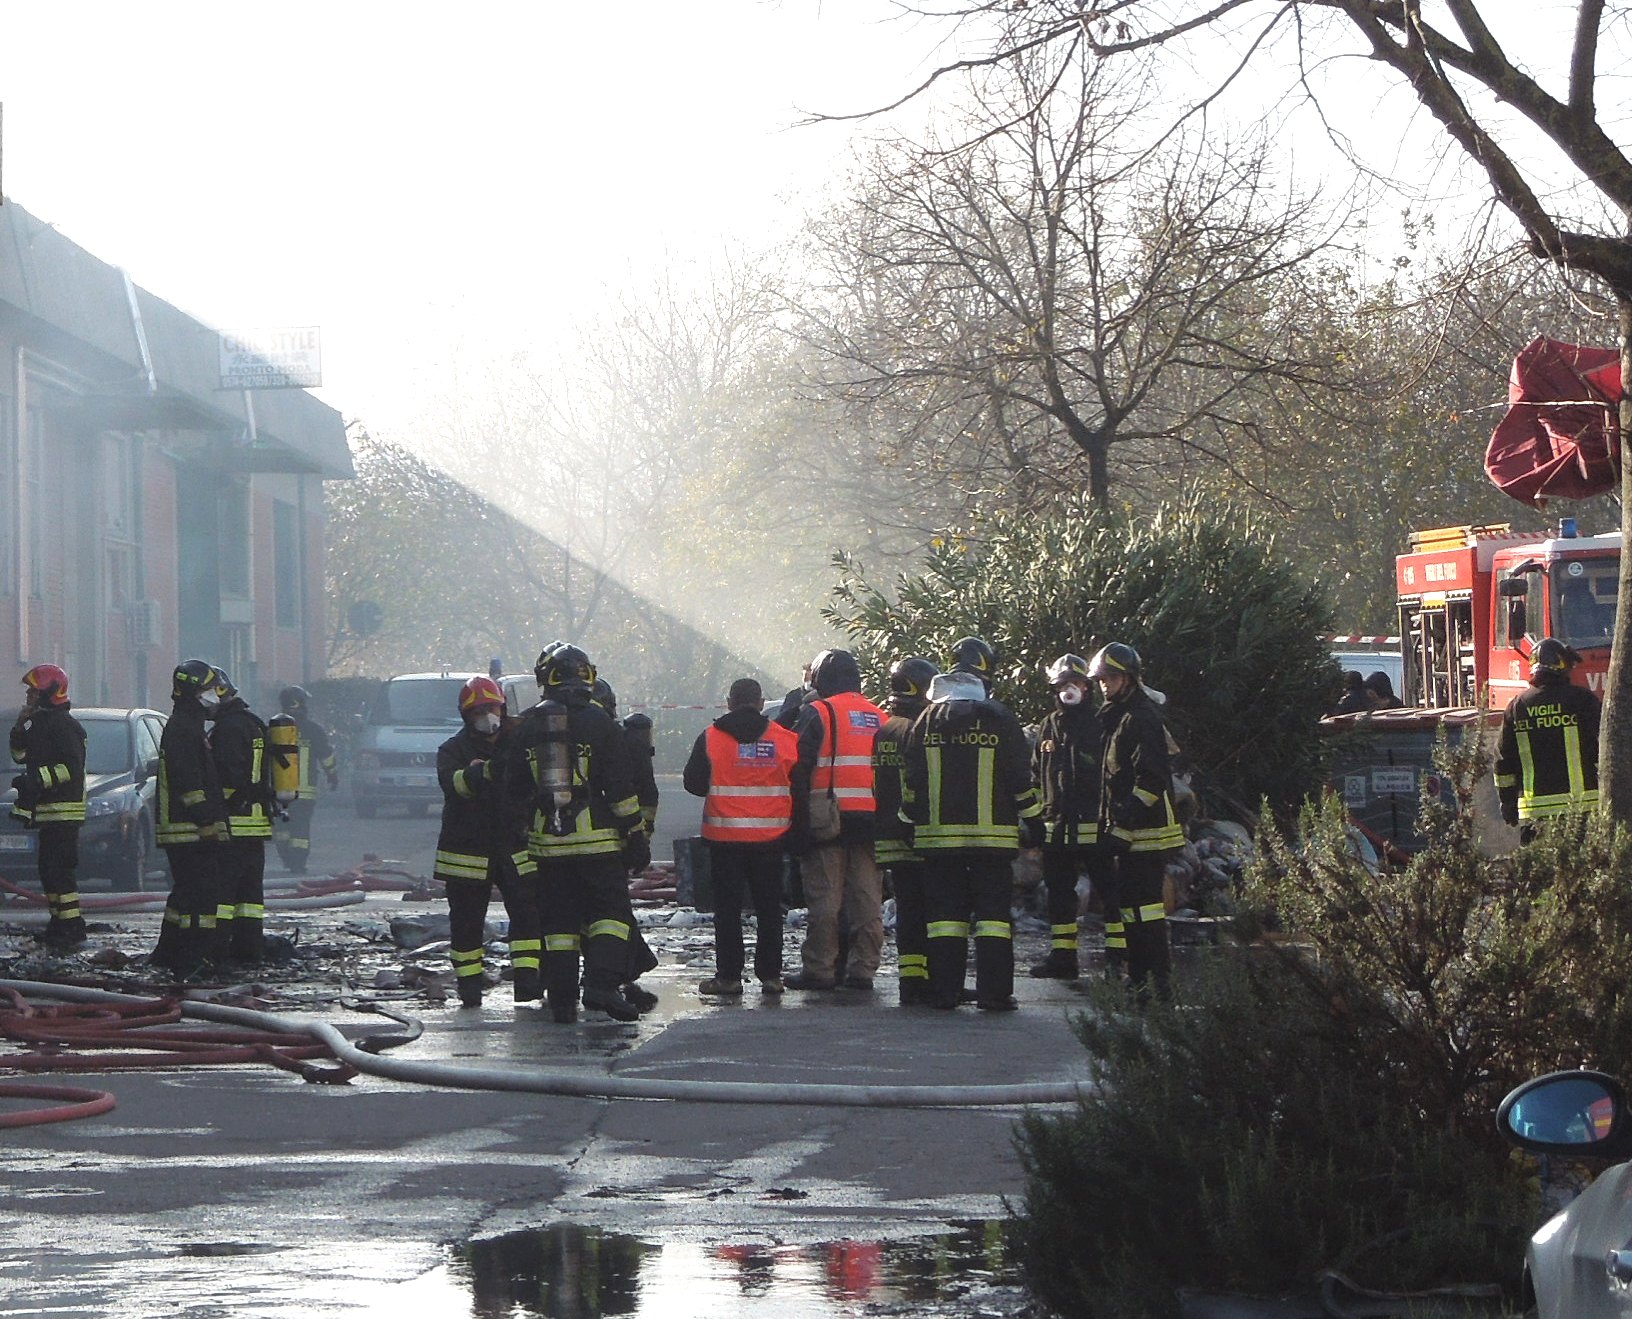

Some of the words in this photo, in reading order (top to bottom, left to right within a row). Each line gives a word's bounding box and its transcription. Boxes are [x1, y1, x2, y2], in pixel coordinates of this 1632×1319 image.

[223, 333, 264, 353] CHIC
[270, 331, 315, 351] STYLE
[228, 365, 274, 375] PRONTO
[277, 364, 312, 373] MODA
[1527, 703, 1562, 717] VIGILI
[1536, 713, 1578, 729] FUOCO
[923, 732, 946, 746] DEL
